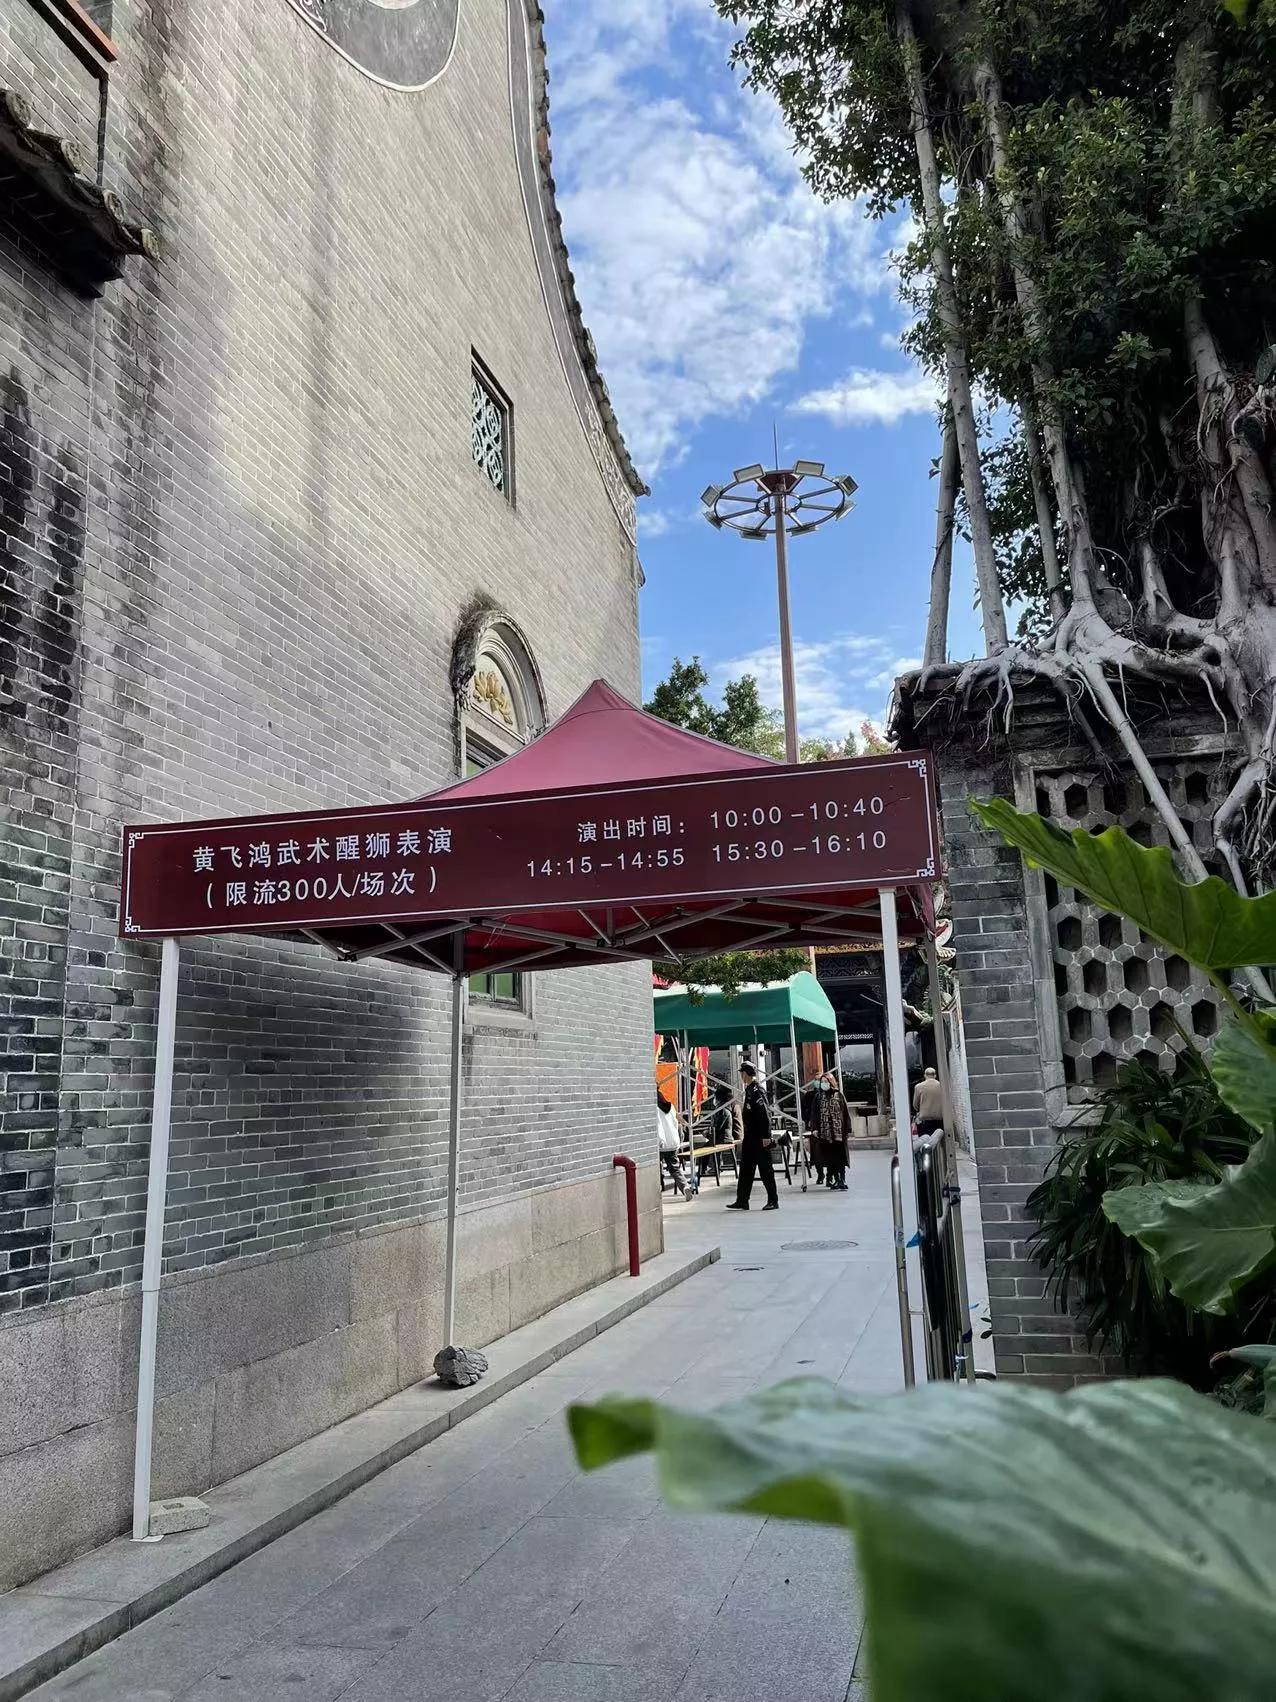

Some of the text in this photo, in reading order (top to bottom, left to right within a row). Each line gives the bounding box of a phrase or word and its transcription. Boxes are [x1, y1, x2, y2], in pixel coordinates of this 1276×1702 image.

[192, 826, 453, 872] 黄飞鸿武术醒狮表演
